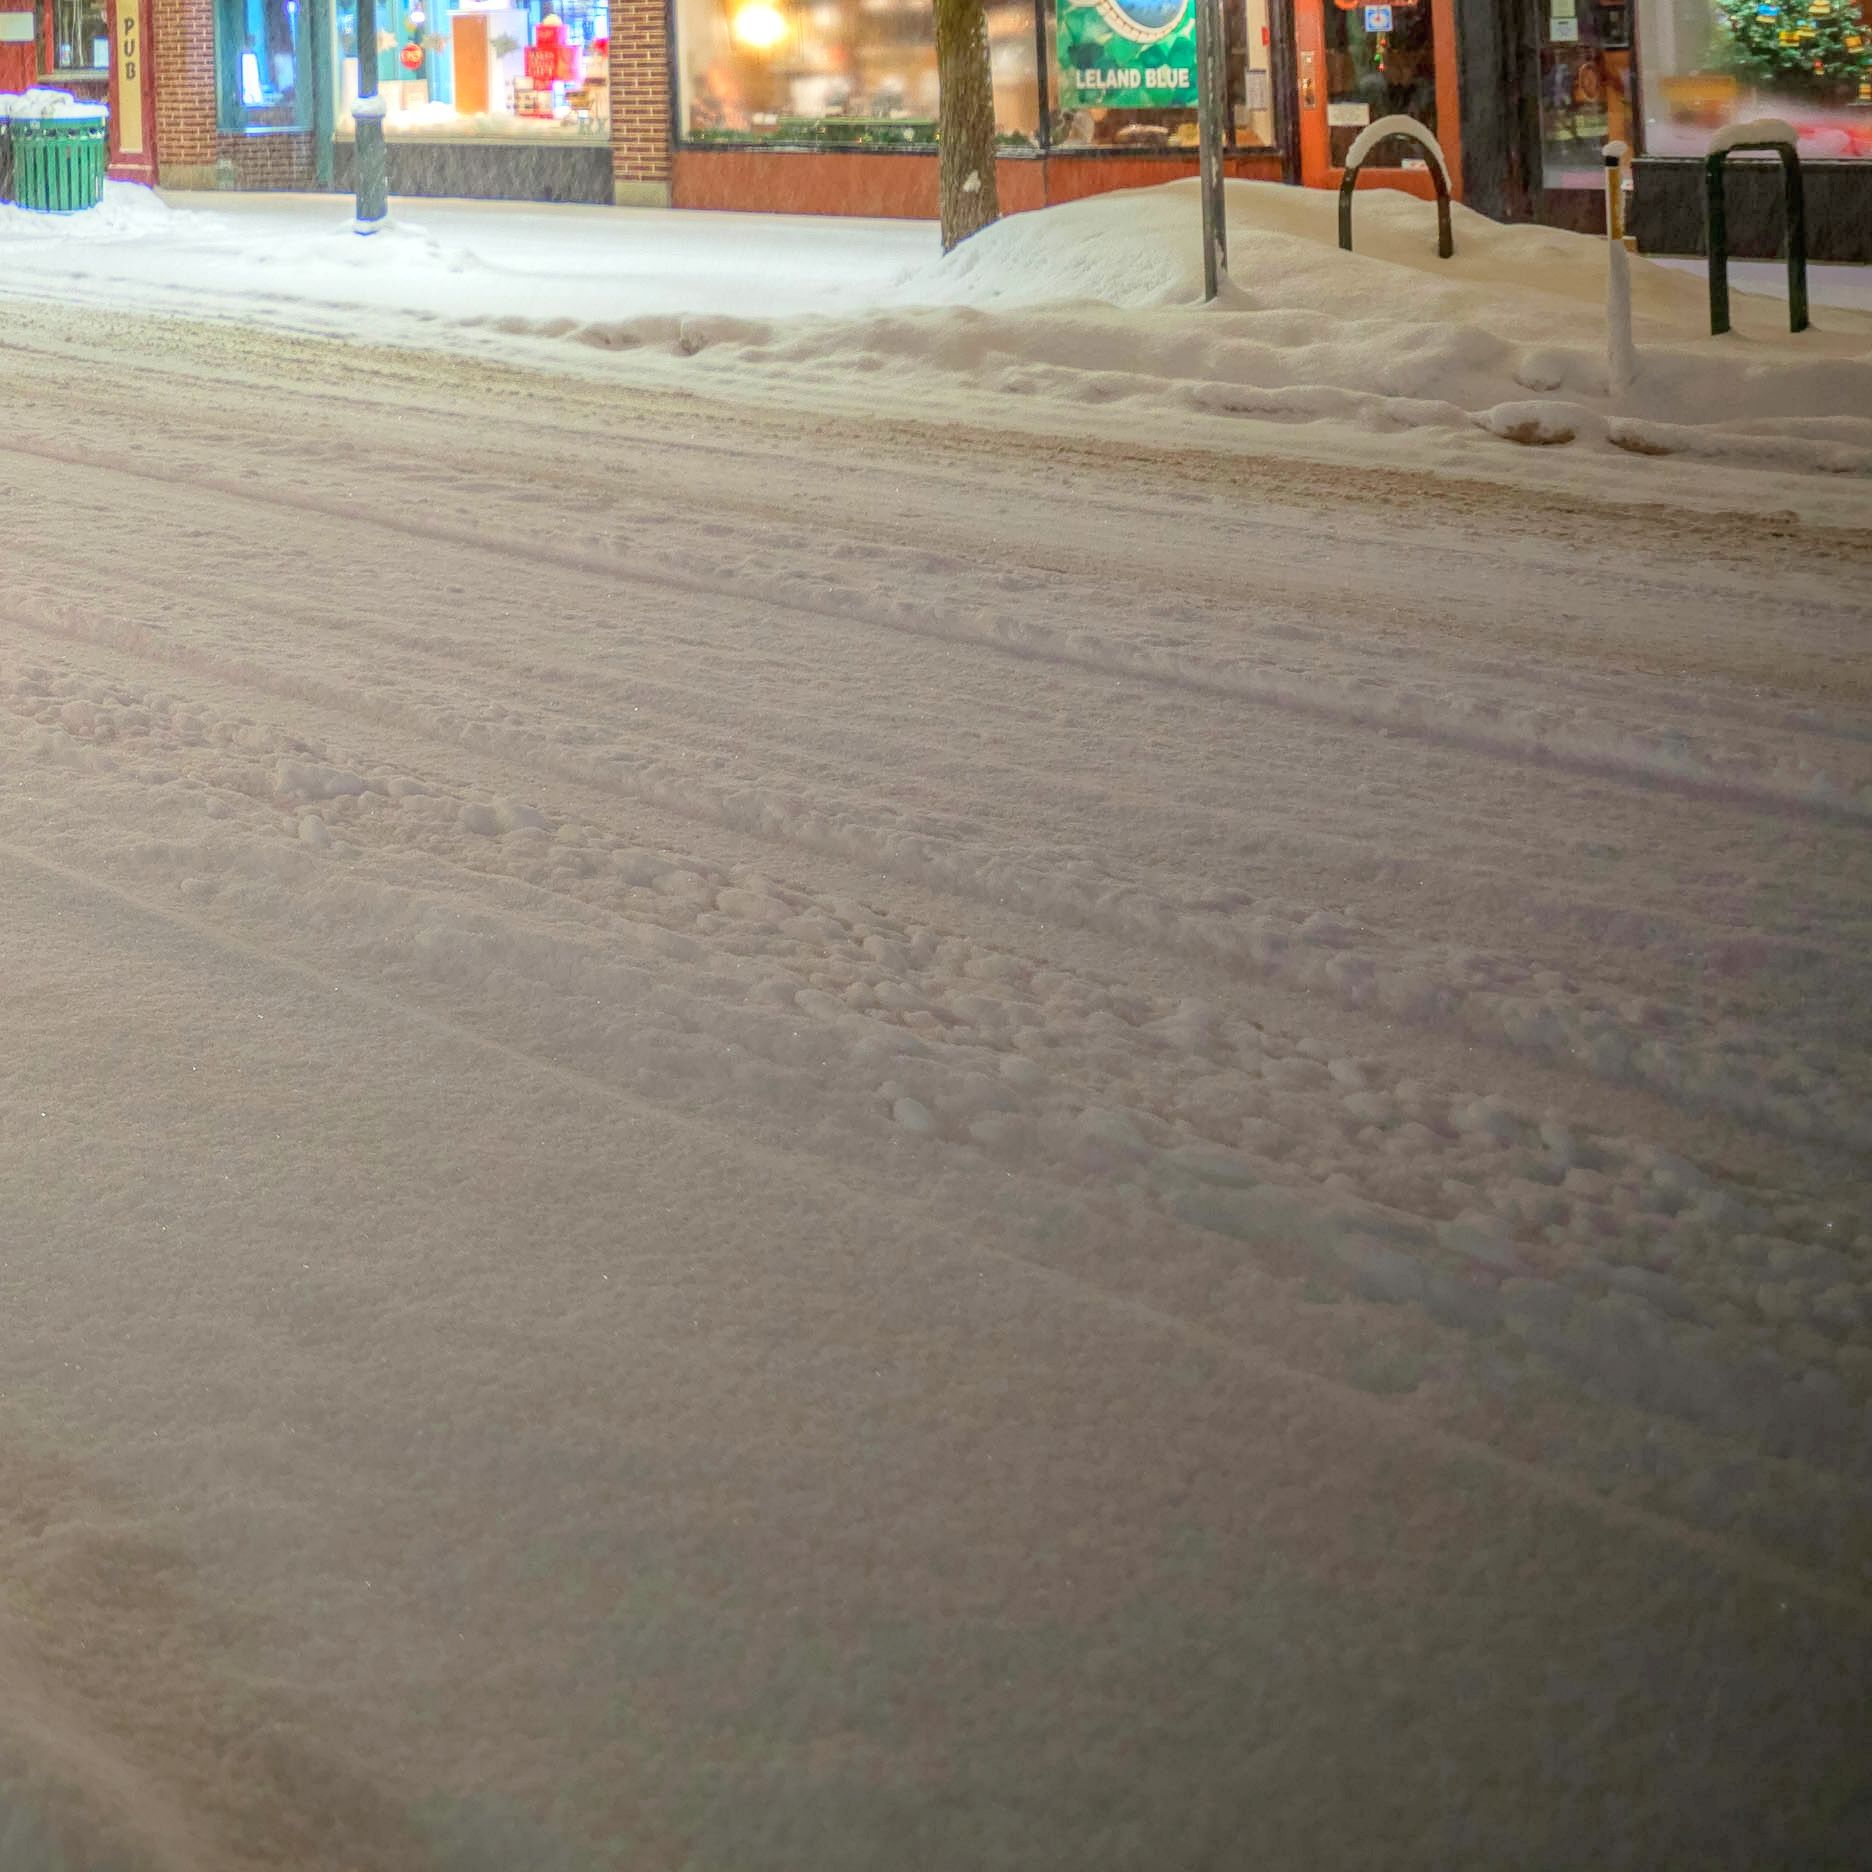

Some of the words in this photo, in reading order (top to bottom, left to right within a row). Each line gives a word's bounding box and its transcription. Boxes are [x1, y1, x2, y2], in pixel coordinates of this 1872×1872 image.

[123, 17, 137, 80] PUB
[1076, 68, 1142, 89] LELAND
[1145, 67, 1190, 89] BLUE
